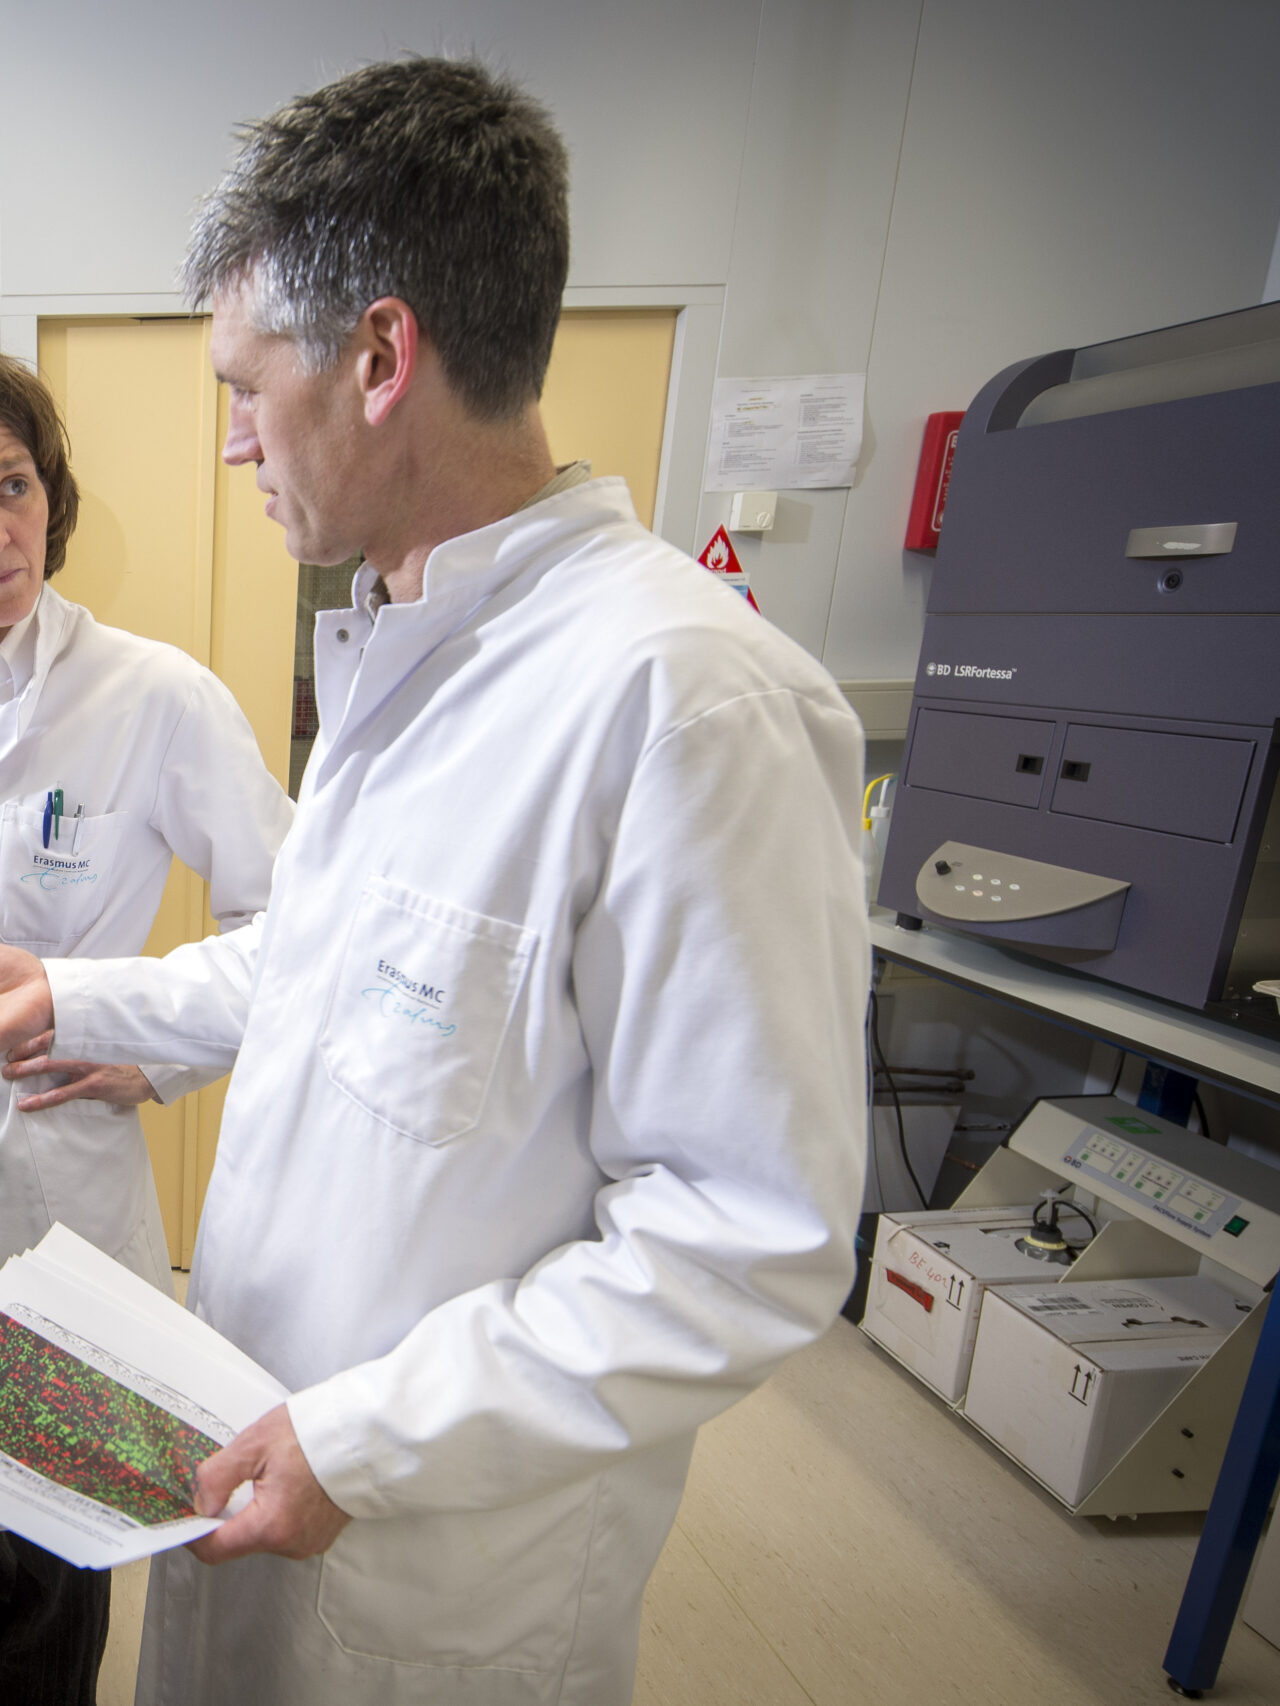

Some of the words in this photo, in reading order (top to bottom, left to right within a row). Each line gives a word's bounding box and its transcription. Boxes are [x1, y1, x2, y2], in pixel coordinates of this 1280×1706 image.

[937, 664, 951, 676] BD
[33, 855, 77, 869] Erasmus
[77, 859, 91, 869] MC
[377, 959, 418, 993] Erasmus
[418, 983, 446, 1004] MC
[1070, 1158, 1082, 1169] BD
